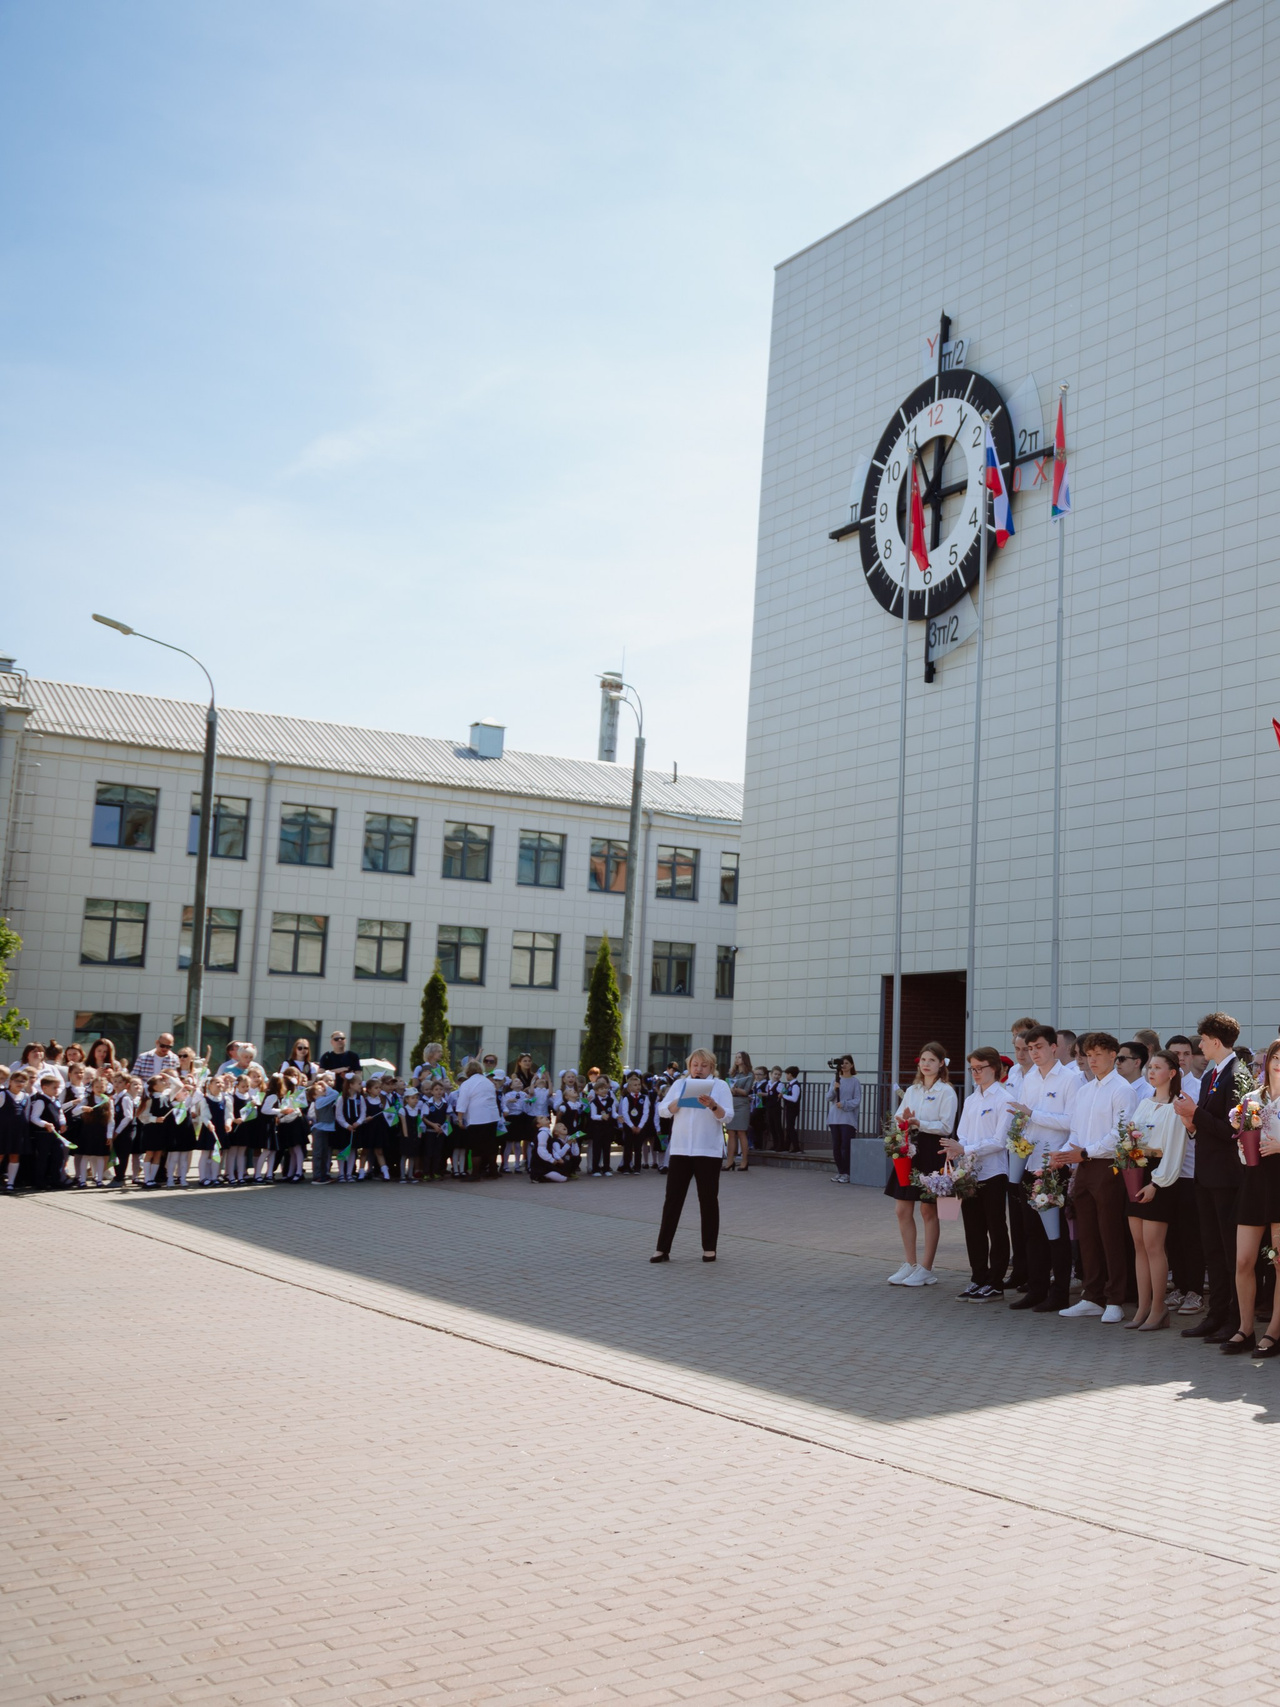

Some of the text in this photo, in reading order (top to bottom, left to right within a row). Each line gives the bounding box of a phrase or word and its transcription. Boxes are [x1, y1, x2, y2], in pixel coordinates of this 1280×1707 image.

[926, 333, 939, 358] Y
[927, 403, 944, 428] 12
[957, 404, 964, 426] 1
[905, 424, 918, 445] 11
[972, 426, 981, 449] 2
[886, 460, 901, 484] 10
[879, 502, 888, 523] 9
[968, 507, 978, 528] 4
[883, 538, 892, 560] 8
[948, 543, 958, 566] 5
[923, 563, 932, 585] 6
